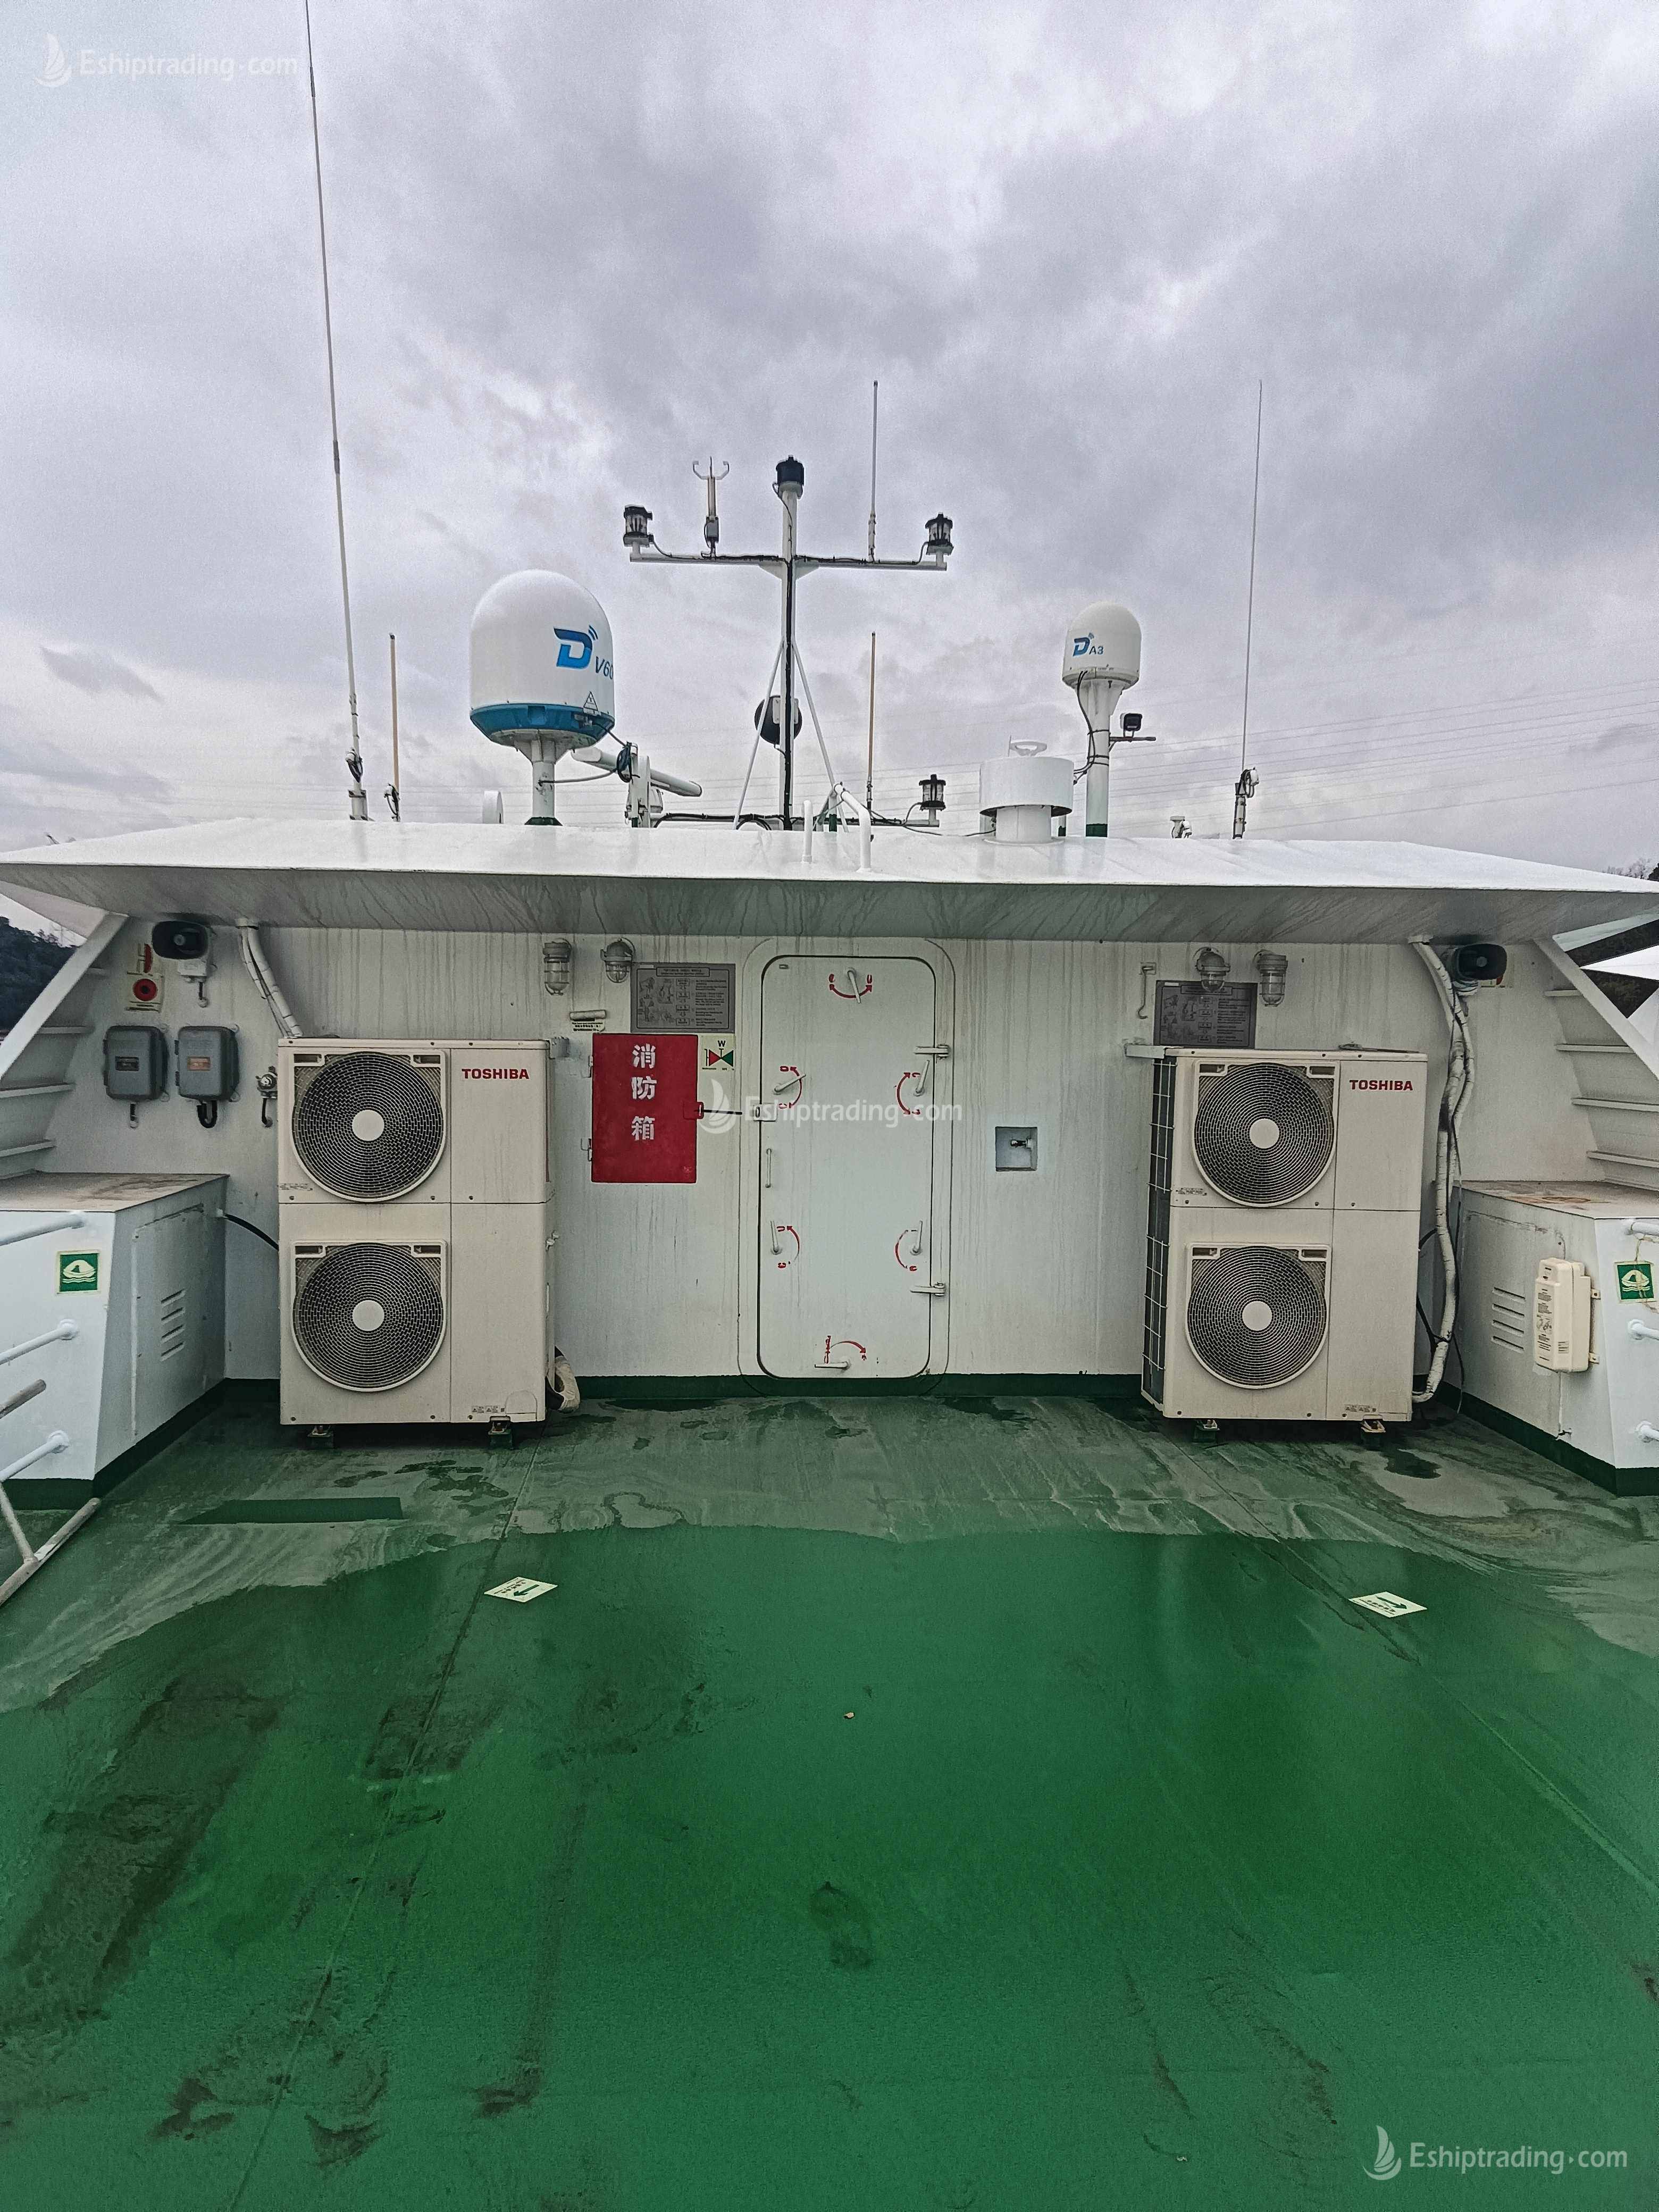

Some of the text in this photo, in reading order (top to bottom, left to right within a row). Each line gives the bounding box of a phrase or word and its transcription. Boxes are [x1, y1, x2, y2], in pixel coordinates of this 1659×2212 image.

[1089, 646, 1104, 655] A3
[462, 1068, 530, 1079] TOSHIBA
[1349, 1079, 1413, 1091] TOSHIBA
[631, 1043, 657, 1141] 消防箱
